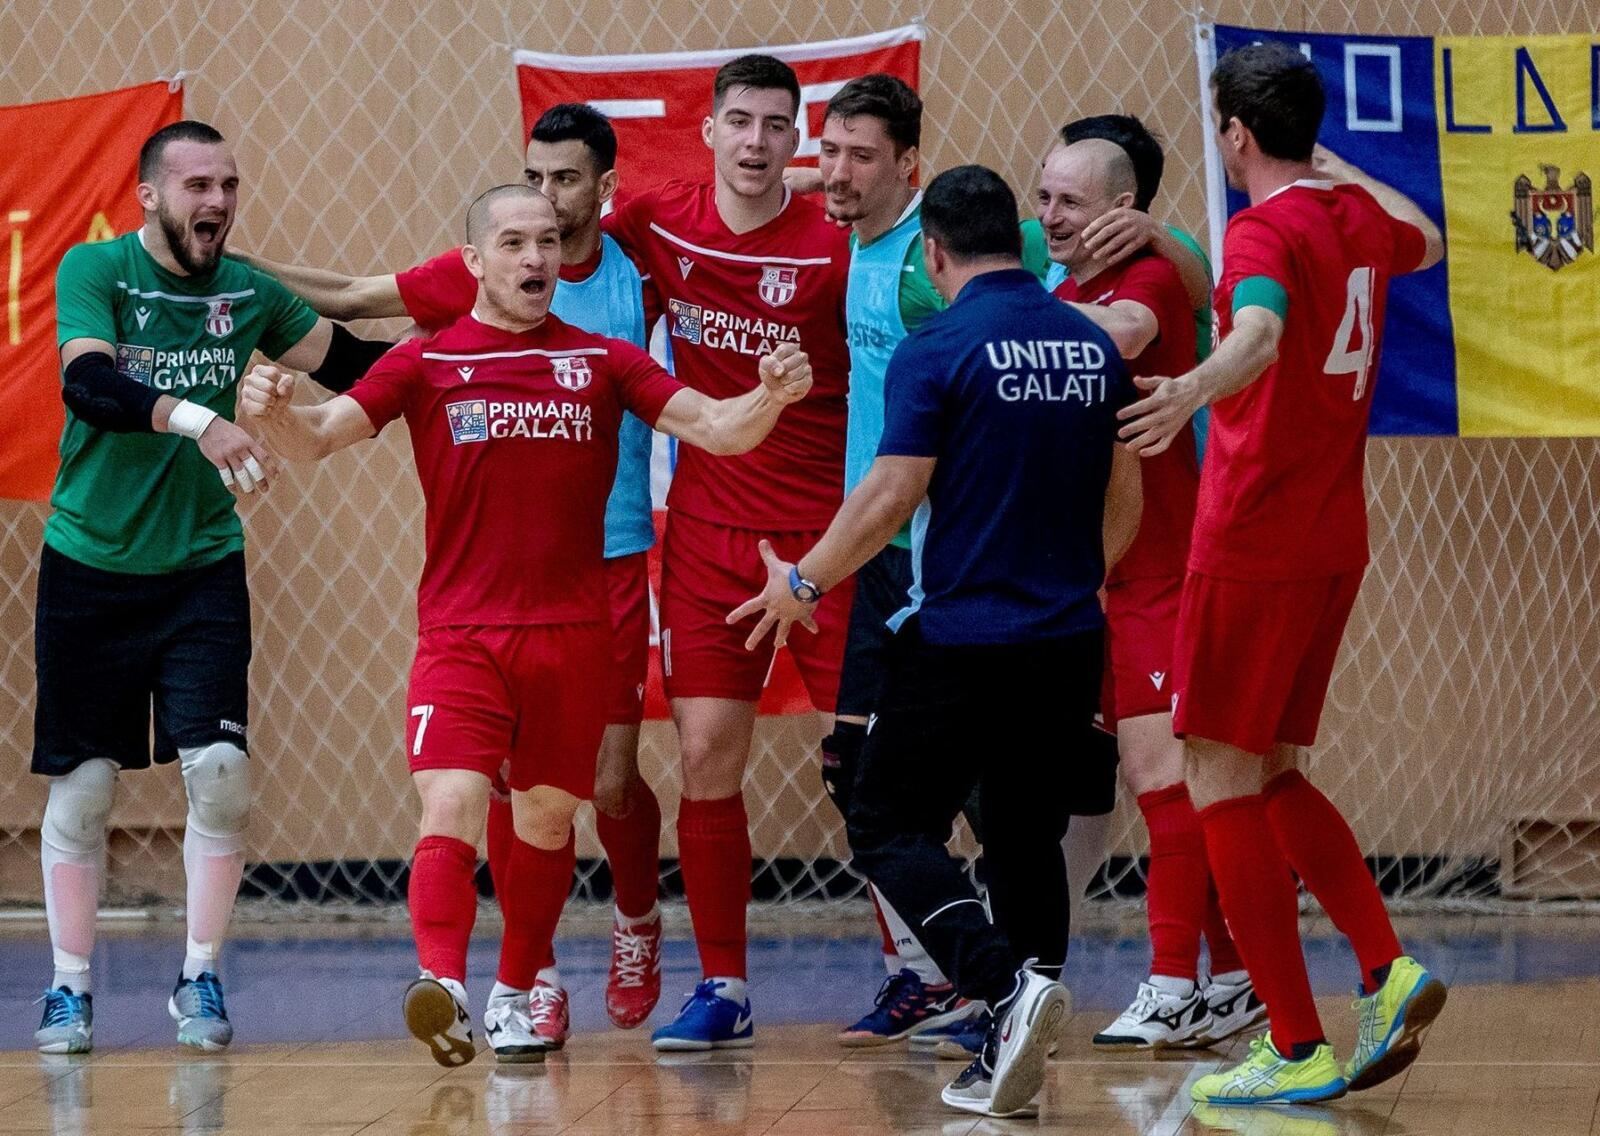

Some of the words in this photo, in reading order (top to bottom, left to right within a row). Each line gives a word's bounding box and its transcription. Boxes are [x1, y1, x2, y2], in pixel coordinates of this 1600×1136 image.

[703, 327, 801, 356] GALA
[1323, 266, 1376, 402] 4
[986, 339, 1106, 370] UNITED
[997, 373, 1106, 407] GALAȚI
[411, 704, 435, 756] 7
